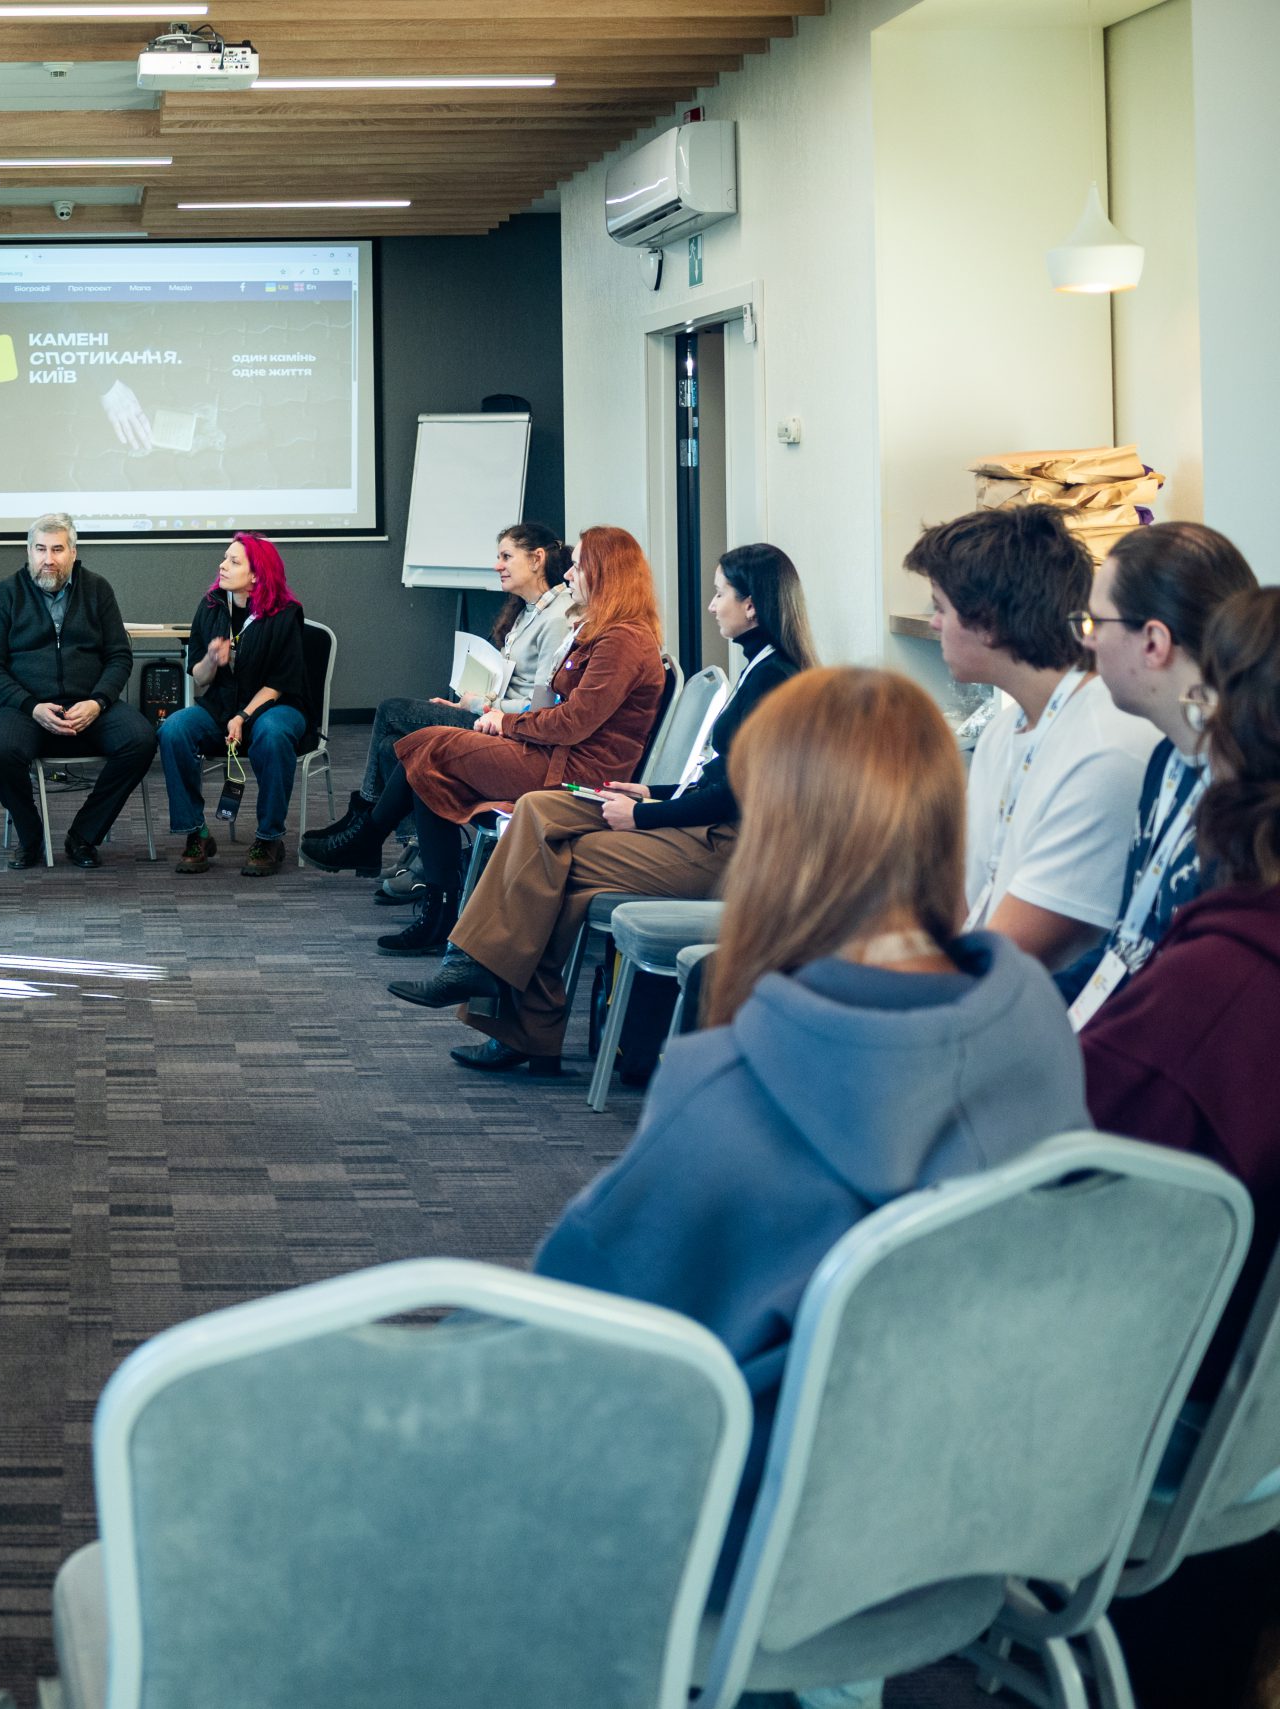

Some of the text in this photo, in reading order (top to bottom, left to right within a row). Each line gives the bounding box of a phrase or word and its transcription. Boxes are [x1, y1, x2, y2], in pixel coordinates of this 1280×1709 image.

[29, 333, 108, 346] КАМЕНІ
[29, 350, 182, 365] СПОТИКАННЯ.
[232, 352, 317, 363] один камінь
[29, 367, 77, 383] КИЇВ
[232, 368, 312, 377] одне життя
